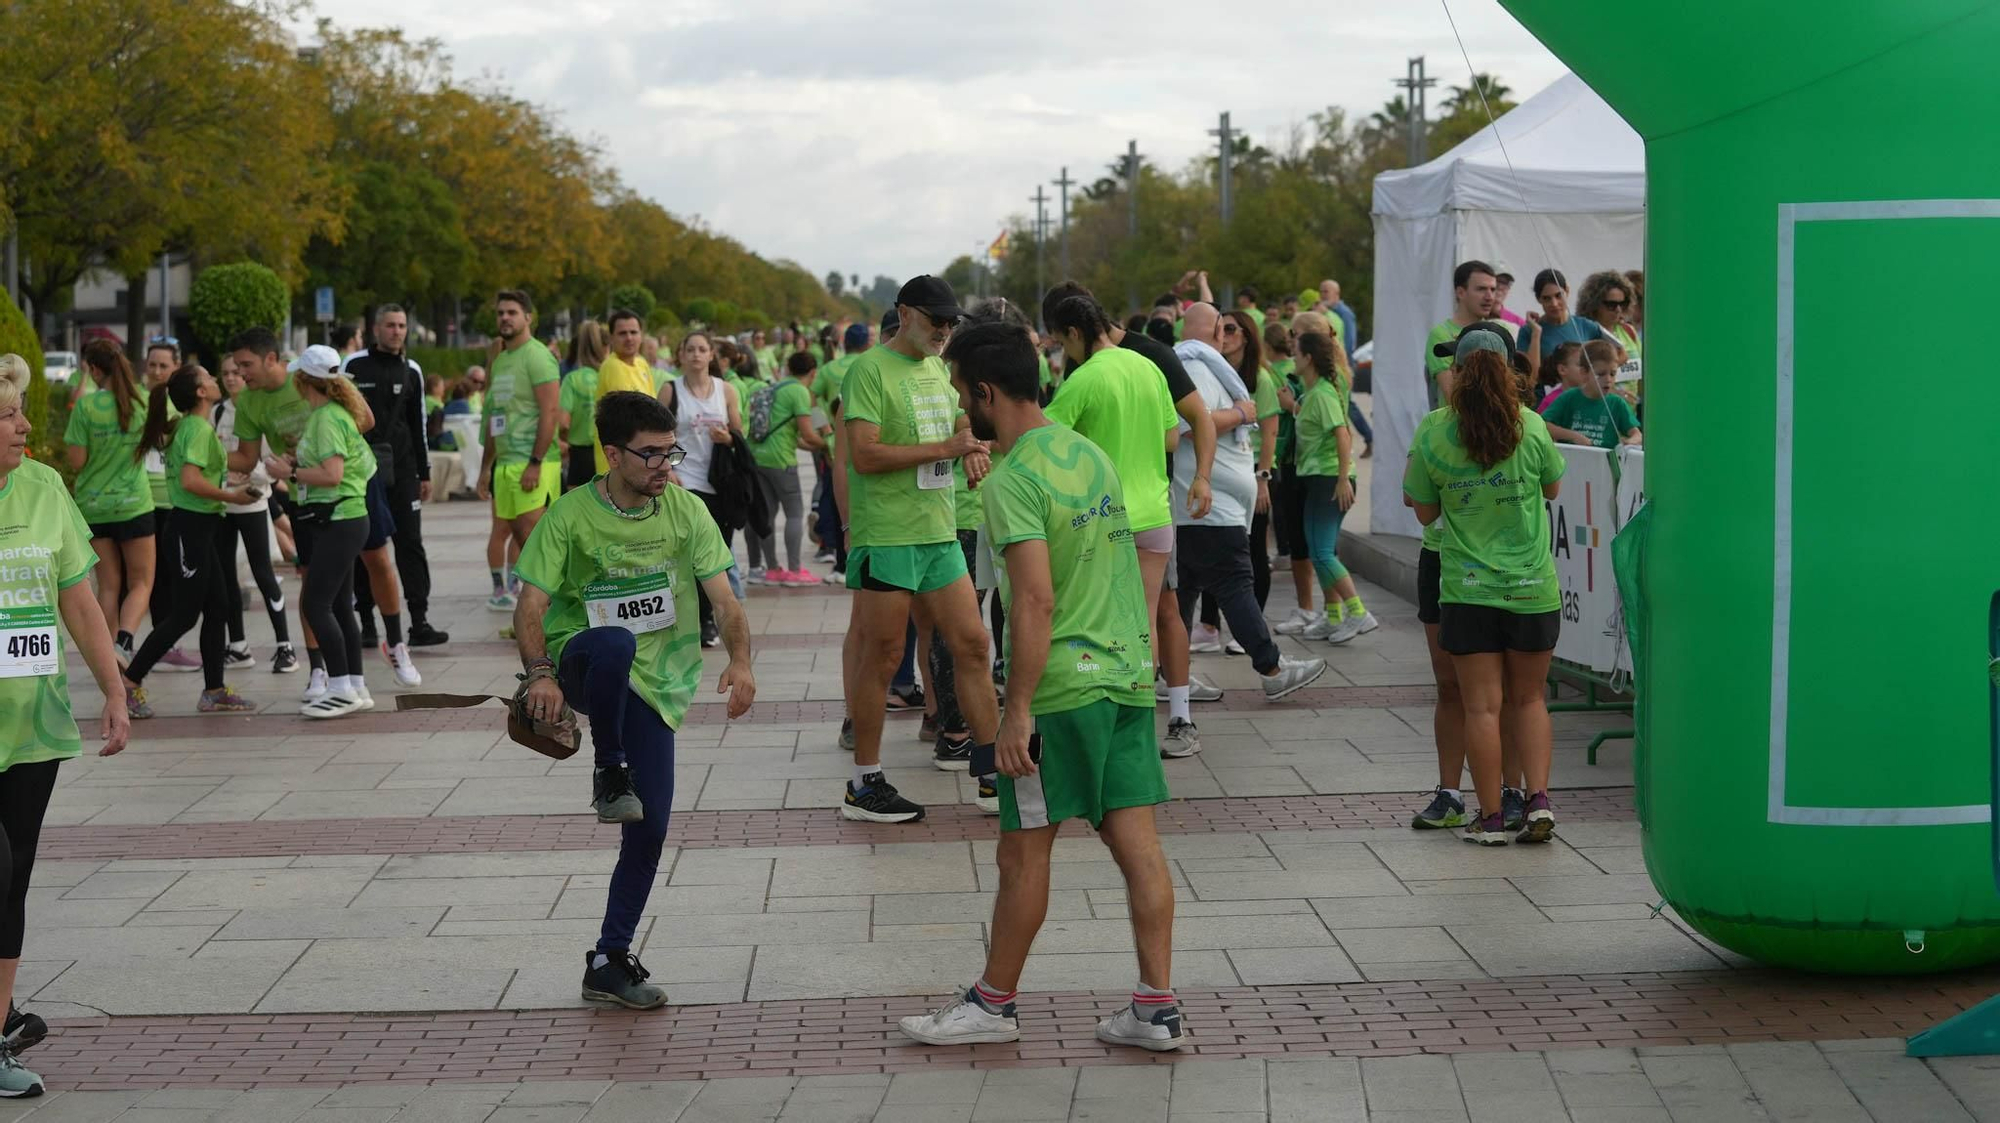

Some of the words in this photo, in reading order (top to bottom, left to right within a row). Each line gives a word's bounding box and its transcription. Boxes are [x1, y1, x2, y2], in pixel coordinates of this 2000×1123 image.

[588, 585, 618, 593] Córdoba
[617, 596, 665, 620] 4852
[8, 633, 51, 658] 4766
